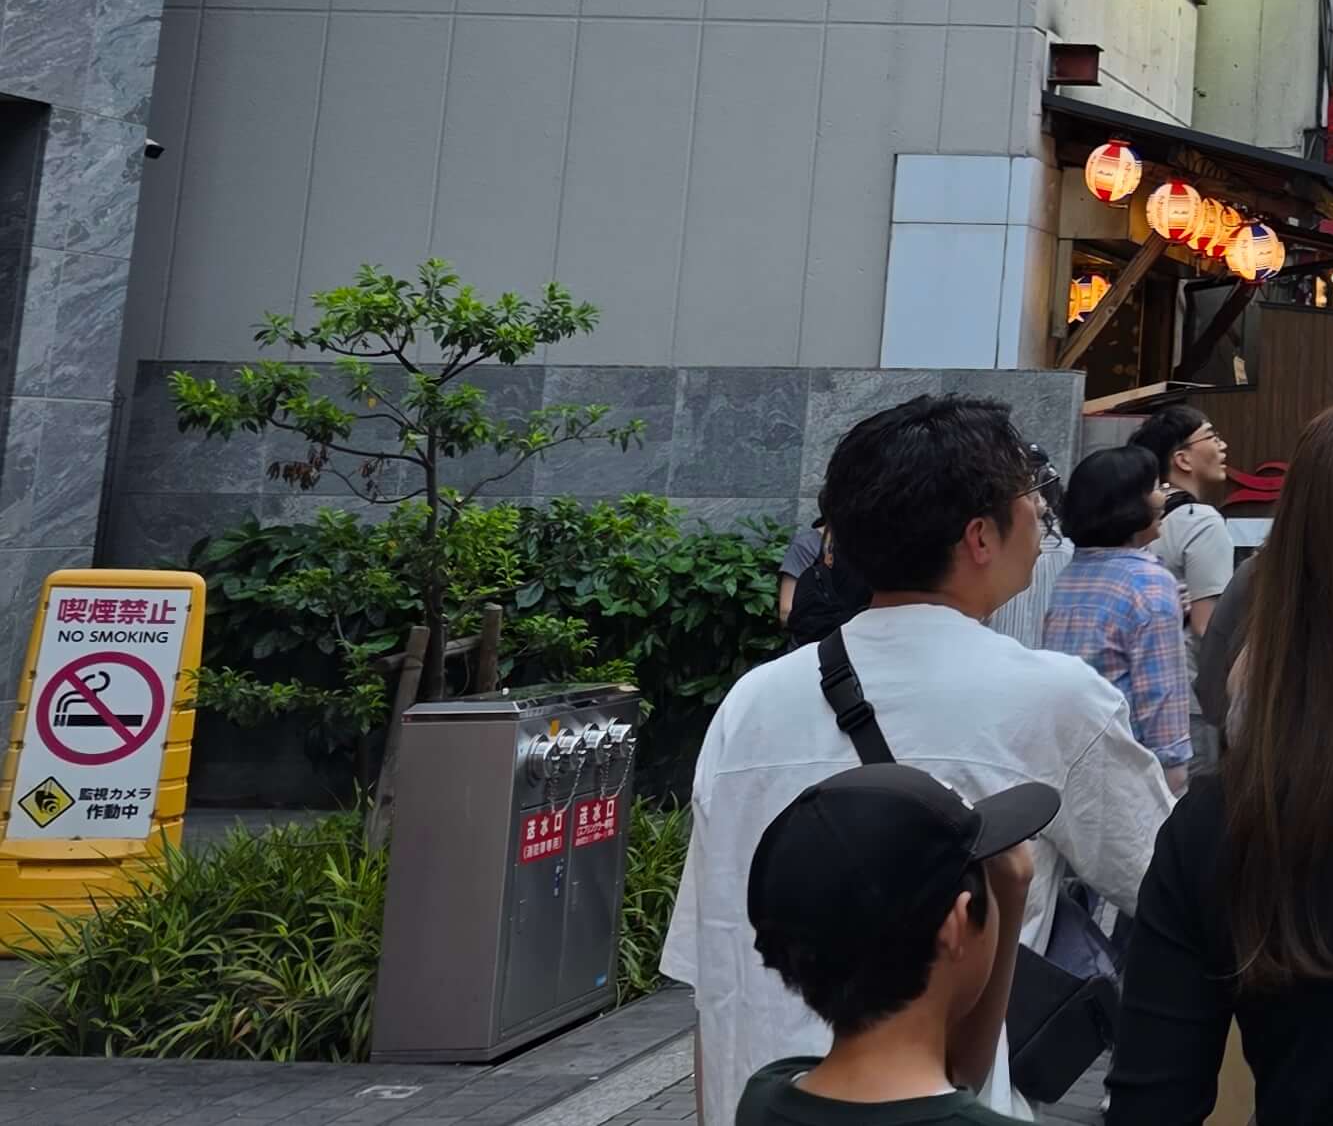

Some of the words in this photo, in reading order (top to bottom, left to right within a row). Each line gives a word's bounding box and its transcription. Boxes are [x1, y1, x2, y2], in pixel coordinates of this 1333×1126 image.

[57, 598, 177, 626] 喫煙禁止
[58, 631, 85, 643] NO
[89, 631, 169, 643] SMOKING
[78, 786, 152, 803] 監視カメラ
[86, 803, 140, 821] 作動中
[578, 799, 615, 825] 送水口
[526, 813, 562, 841] 送水口
